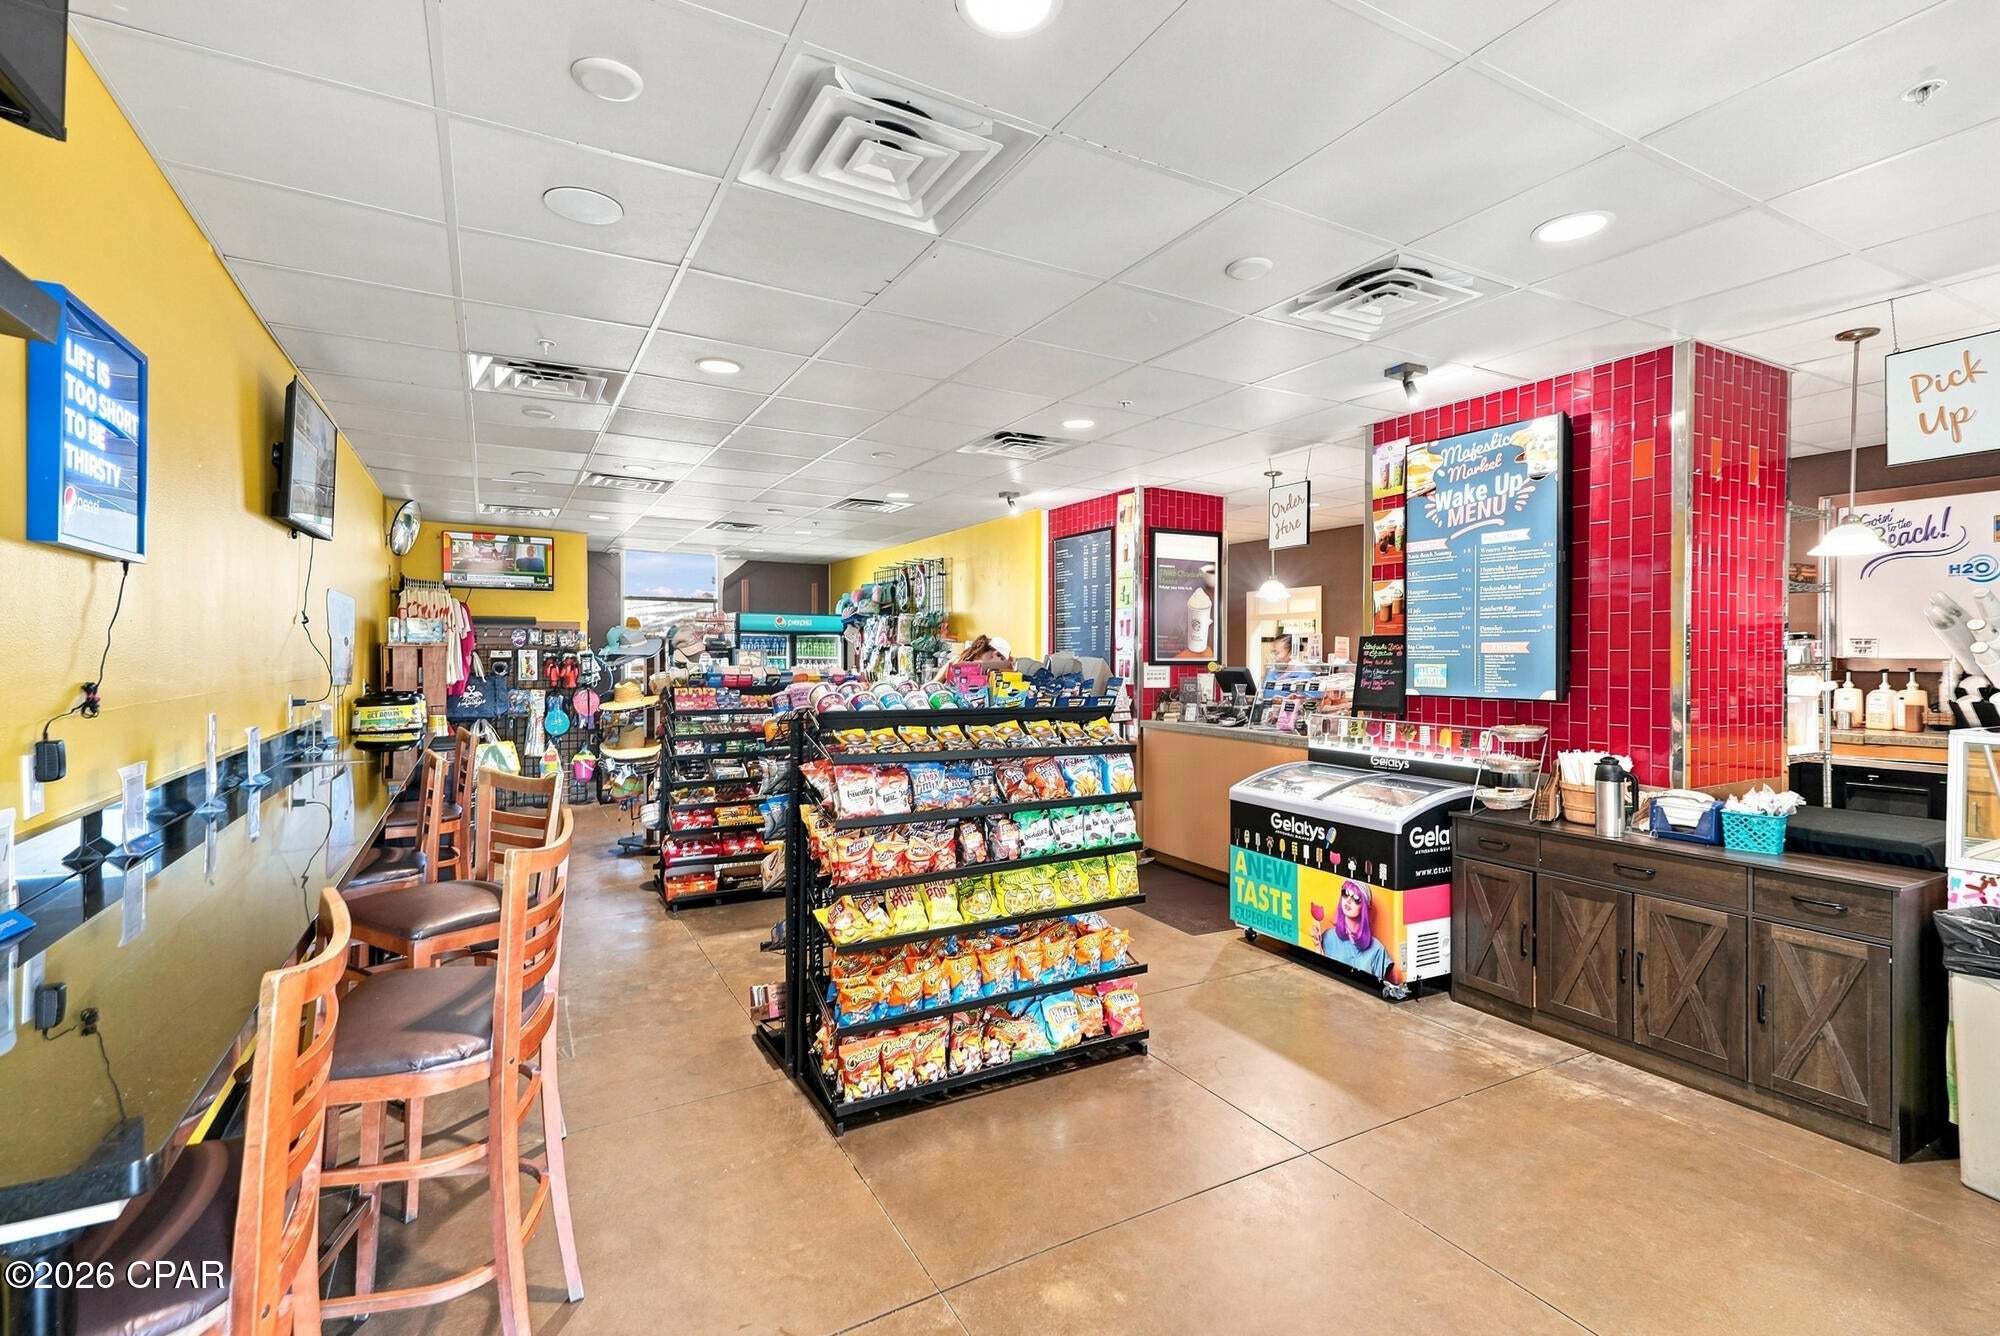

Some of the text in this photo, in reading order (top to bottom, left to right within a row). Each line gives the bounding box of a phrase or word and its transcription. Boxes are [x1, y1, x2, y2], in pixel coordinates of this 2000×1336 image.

[66, 337, 111, 390] LIFE IS
[1909, 350, 1988, 403] Pick
[65, 371, 139, 438] TOO SHORT
[64, 406, 106, 451] TO BE
[1919, 405, 1976, 443] Up
[64, 441, 121, 488] THIRSTY
[1441, 432, 1511, 467] Majestic
[1448, 453, 1503, 483] Market
[1272, 493, 1305, 518] Order
[1435, 472, 1523, 512] Wake Up
[1447, 495, 1507, 528] MENU
[1275, 519, 1302, 540] Here
[788, 619, 812, 627] pepsi
[1370, 755, 1410, 770] Gelatys
[1270, 812, 1325, 841] Gelatys
[1409, 825, 1450, 849] Gela
[1235, 850, 1292, 888] A NEW
[891, 892, 914, 909] POP
[925, 886, 948, 900] POP
[1234, 876, 1293, 921] TASTE
[1234, 904, 1294, 938] EXPERIENCE
[845, 1047, 879, 1071] Cheetos
